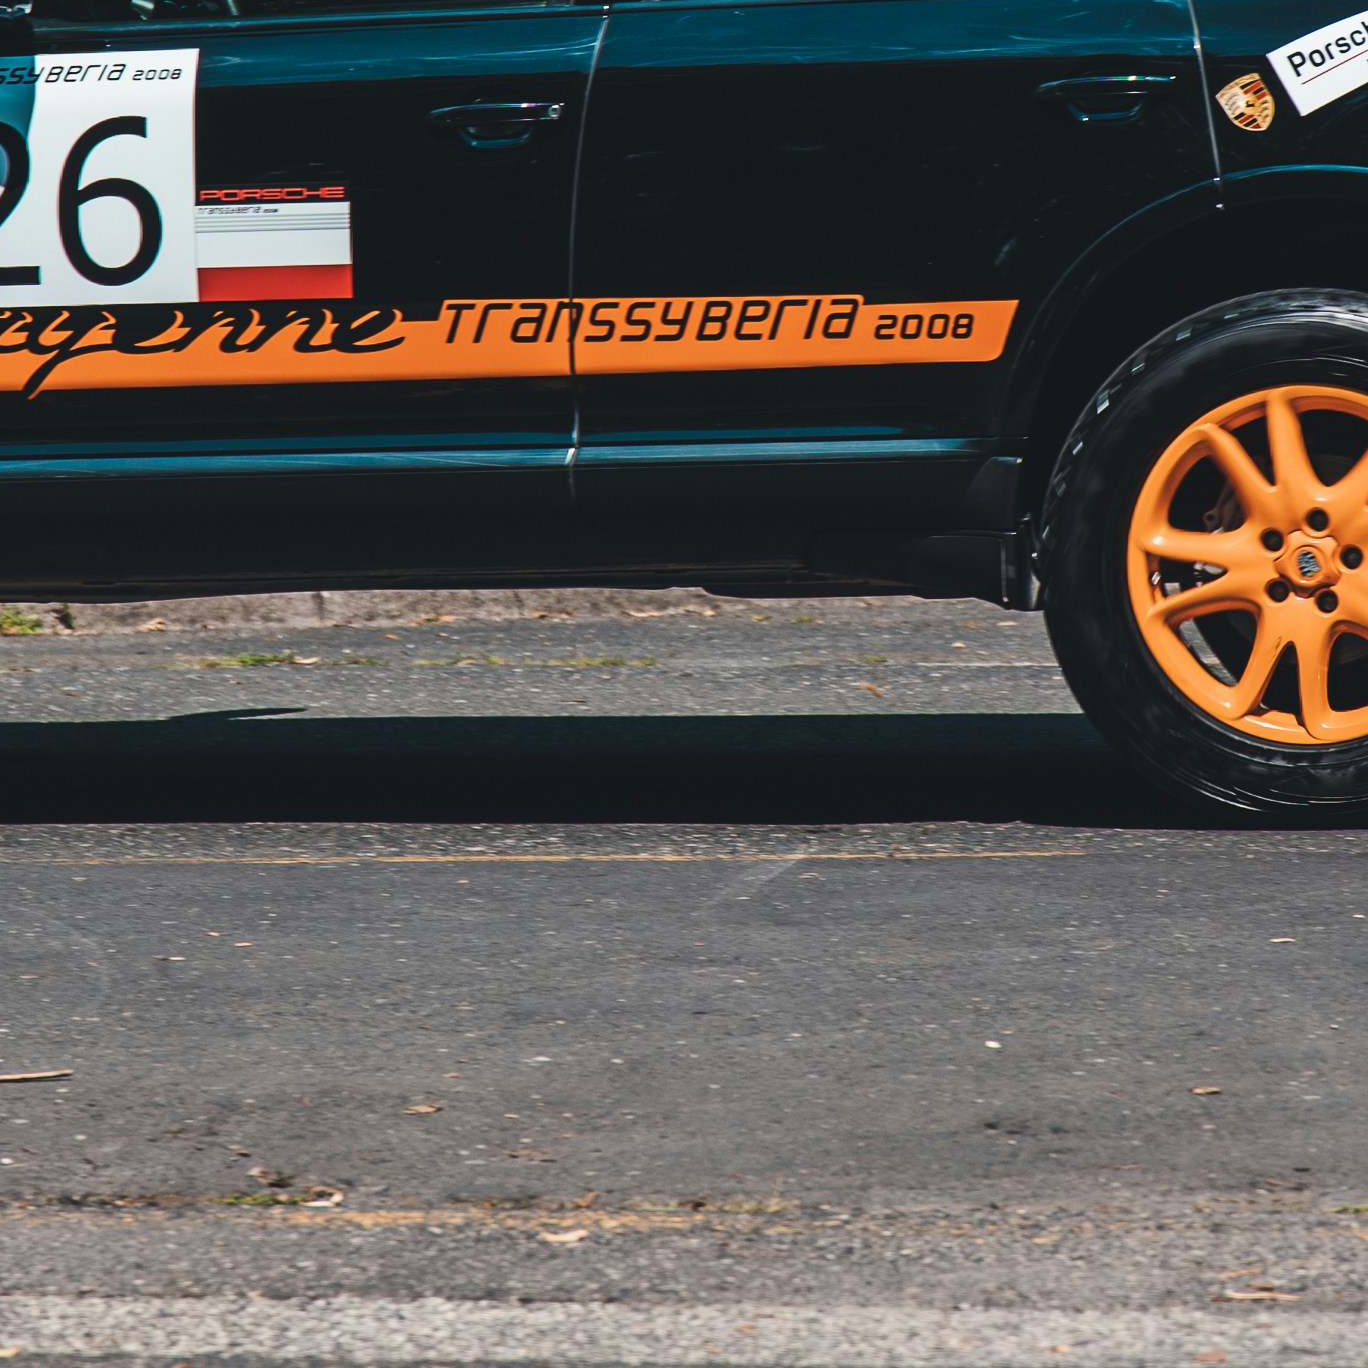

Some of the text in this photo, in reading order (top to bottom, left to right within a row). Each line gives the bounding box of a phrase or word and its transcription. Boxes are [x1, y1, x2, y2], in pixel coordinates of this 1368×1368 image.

[132, 68, 182, 81] 2008
[200, 187, 345, 201] PORSCHE
[874, 313, 974, 340] 2008
